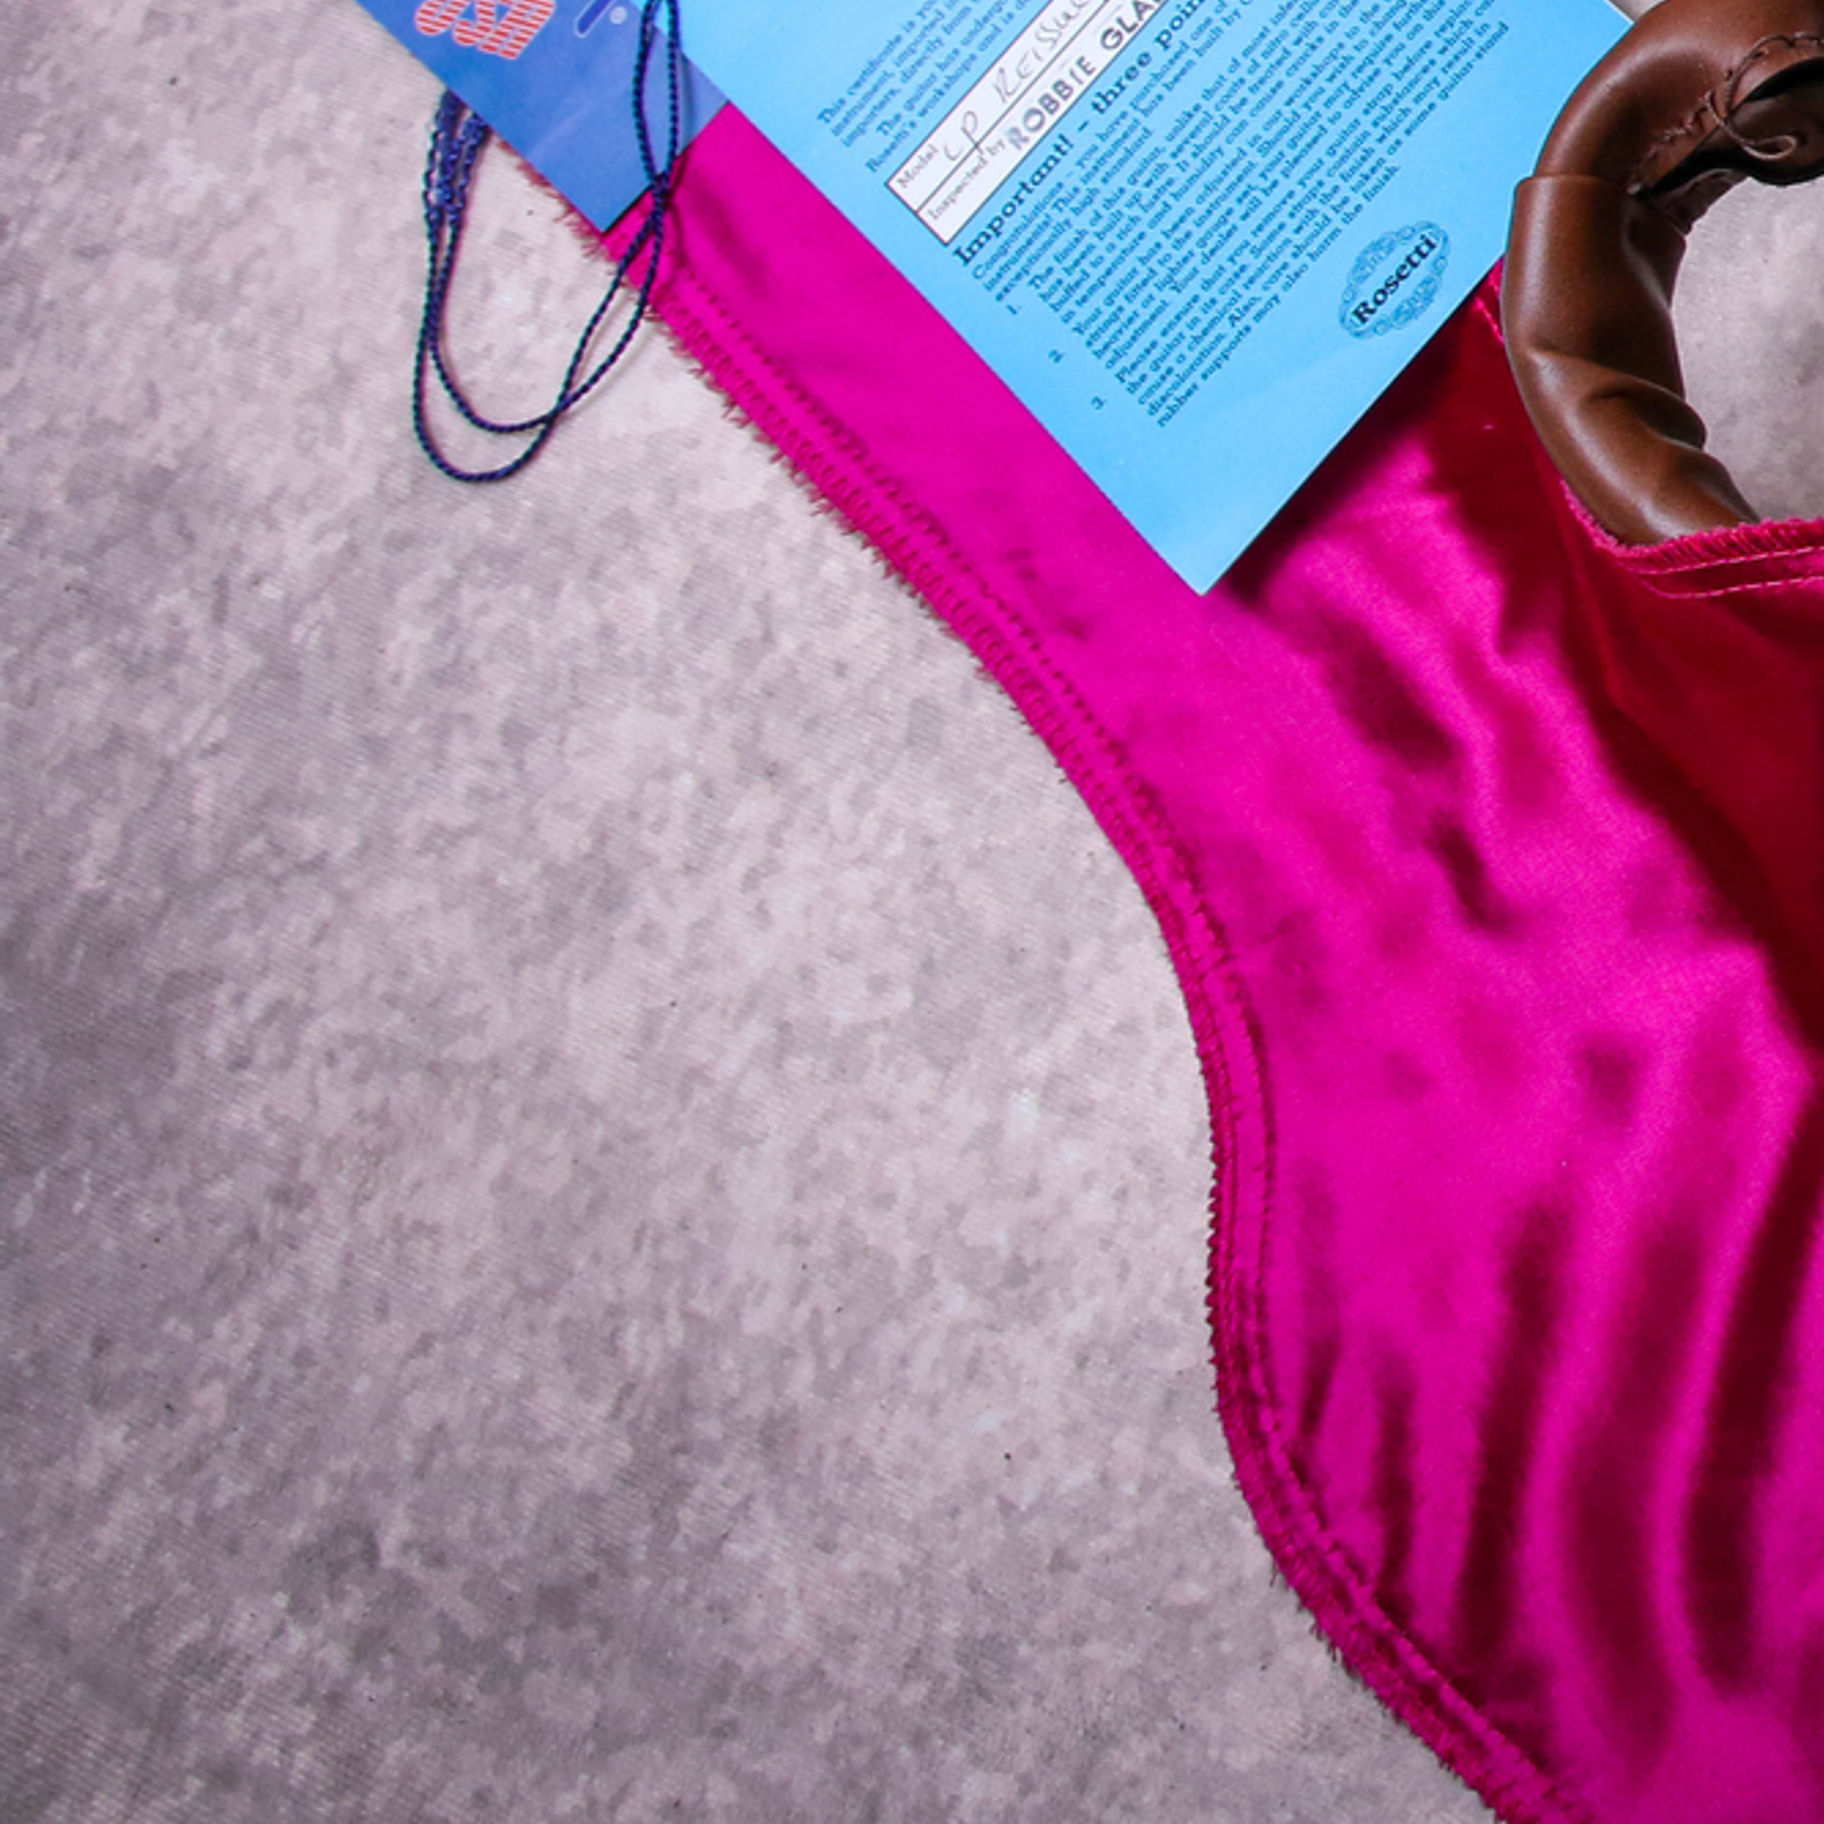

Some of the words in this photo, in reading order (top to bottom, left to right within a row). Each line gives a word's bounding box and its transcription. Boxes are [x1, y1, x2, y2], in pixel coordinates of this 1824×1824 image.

[815, 96, 847, 124] This
[900, 19, 917, 34] is
[895, 143, 938, 189] Model
[926, 152, 988, 220] Inspected
[983, 137, 1006, 157] by
[952, 133, 1073, 266] Important!
[1090, 51, 1152, 115] three
[1007, 55, 1095, 149] ROBBIE
[1026, 264, 1055, 290] The
[1051, 227, 1090, 265] finish
[1087, 208, 1104, 228] of
[1100, 185, 1127, 211] this
[1164, 102, 1202, 142] unlike
[1199, 73, 1228, 102] that
[1226, 55, 1242, 75] of
[1240, 24, 1271, 59] most
[1036, 276, 1064, 303] has
[1060, 241, 1097, 277] been
[1091, 208, 1125, 242] built
[1122, 189, 1143, 210] up
[1141, 161, 1170, 189] with
[1168, 109, 1214, 160] several
[1213, 75, 1247, 112] coats
[1245, 56, 1262, 76] of
[1047, 267, 1091, 313] buffed
[1087, 253, 1105, 270] to
[1103, 240, 1118, 254] a
[1114, 213, 1142, 241] rich
[1189, 112, 1232, 160] should
[1227, 95, 1249, 116] be
[1246, 45, 1293, 95] treated
[1290, 19, 1319, 47] with
[1059, 308, 1077, 325] in
[1073, 230, 1146, 308] temperature
[1146, 199, 1173, 230] and
[1167, 144, 1225, 202] humidity
[1223, 117, 1249, 145] can
[1248, 78, 1285, 118] cause
[1284, 34, 1325, 78] cracks
[1322, 19, 1340, 35] in
[1113, 338, 1159, 384] Please
[1158, 293, 1201, 338] ensure
[1198, 263, 1227, 293] that
[1225, 238, 1256, 266] you
[1249, 188, 1296, 238] remove
[1295, 156, 1325, 190] your
[1324, 116, 1361, 158] guitar
[1361, 82, 1394, 117] strap
[1389, 39, 1433, 82] before
[1124, 371, 1148, 395] the
[1148, 330, 1186, 373] guitar
[1183, 314, 1202, 332] in
[1198, 295, 1219, 315] its
[1248, 220, 1287, 260] Some
[1286, 178, 1325, 220] straps
[1325, 129, 1372, 178] contain
[1370, 57, 1437, 129] substances
[1436, 17, 1474, 56] which
[1137, 364, 1175, 405] cause
[1174, 351, 1187, 365] a
[1186, 288, 1243, 352] chemical
[1241, 236, 1293, 291] reaction
[1291, 207, 1320, 235] with
[1314, 183, 1341, 206] the
[1337, 145, 1376, 183] finish
[1374, 106, 1413, 145] which
[1411, 74, 1441, 106] may
[1439, 35, 1476, 75] result
[1472, 21, 1491, 38] in
[1260, 260, 1290, 292] care
[1289, 211, 1333, 260] should
[1328, 194, 1351, 215] be
[1348, 156, 1387, 194] taken
[1385, 137, 1403, 156] as
[1402, 100, 1437, 137] some
[1352, 234, 1437, 324] Rosetti
[1156, 381, 1199, 428] rubber
[1199, 323, 1252, 381] supports
[1251, 292, 1281, 324] may
[1280, 261, 1309, 293] also
[1304, 226, 1343, 262] harm
[1339, 202, 1364, 225] the
